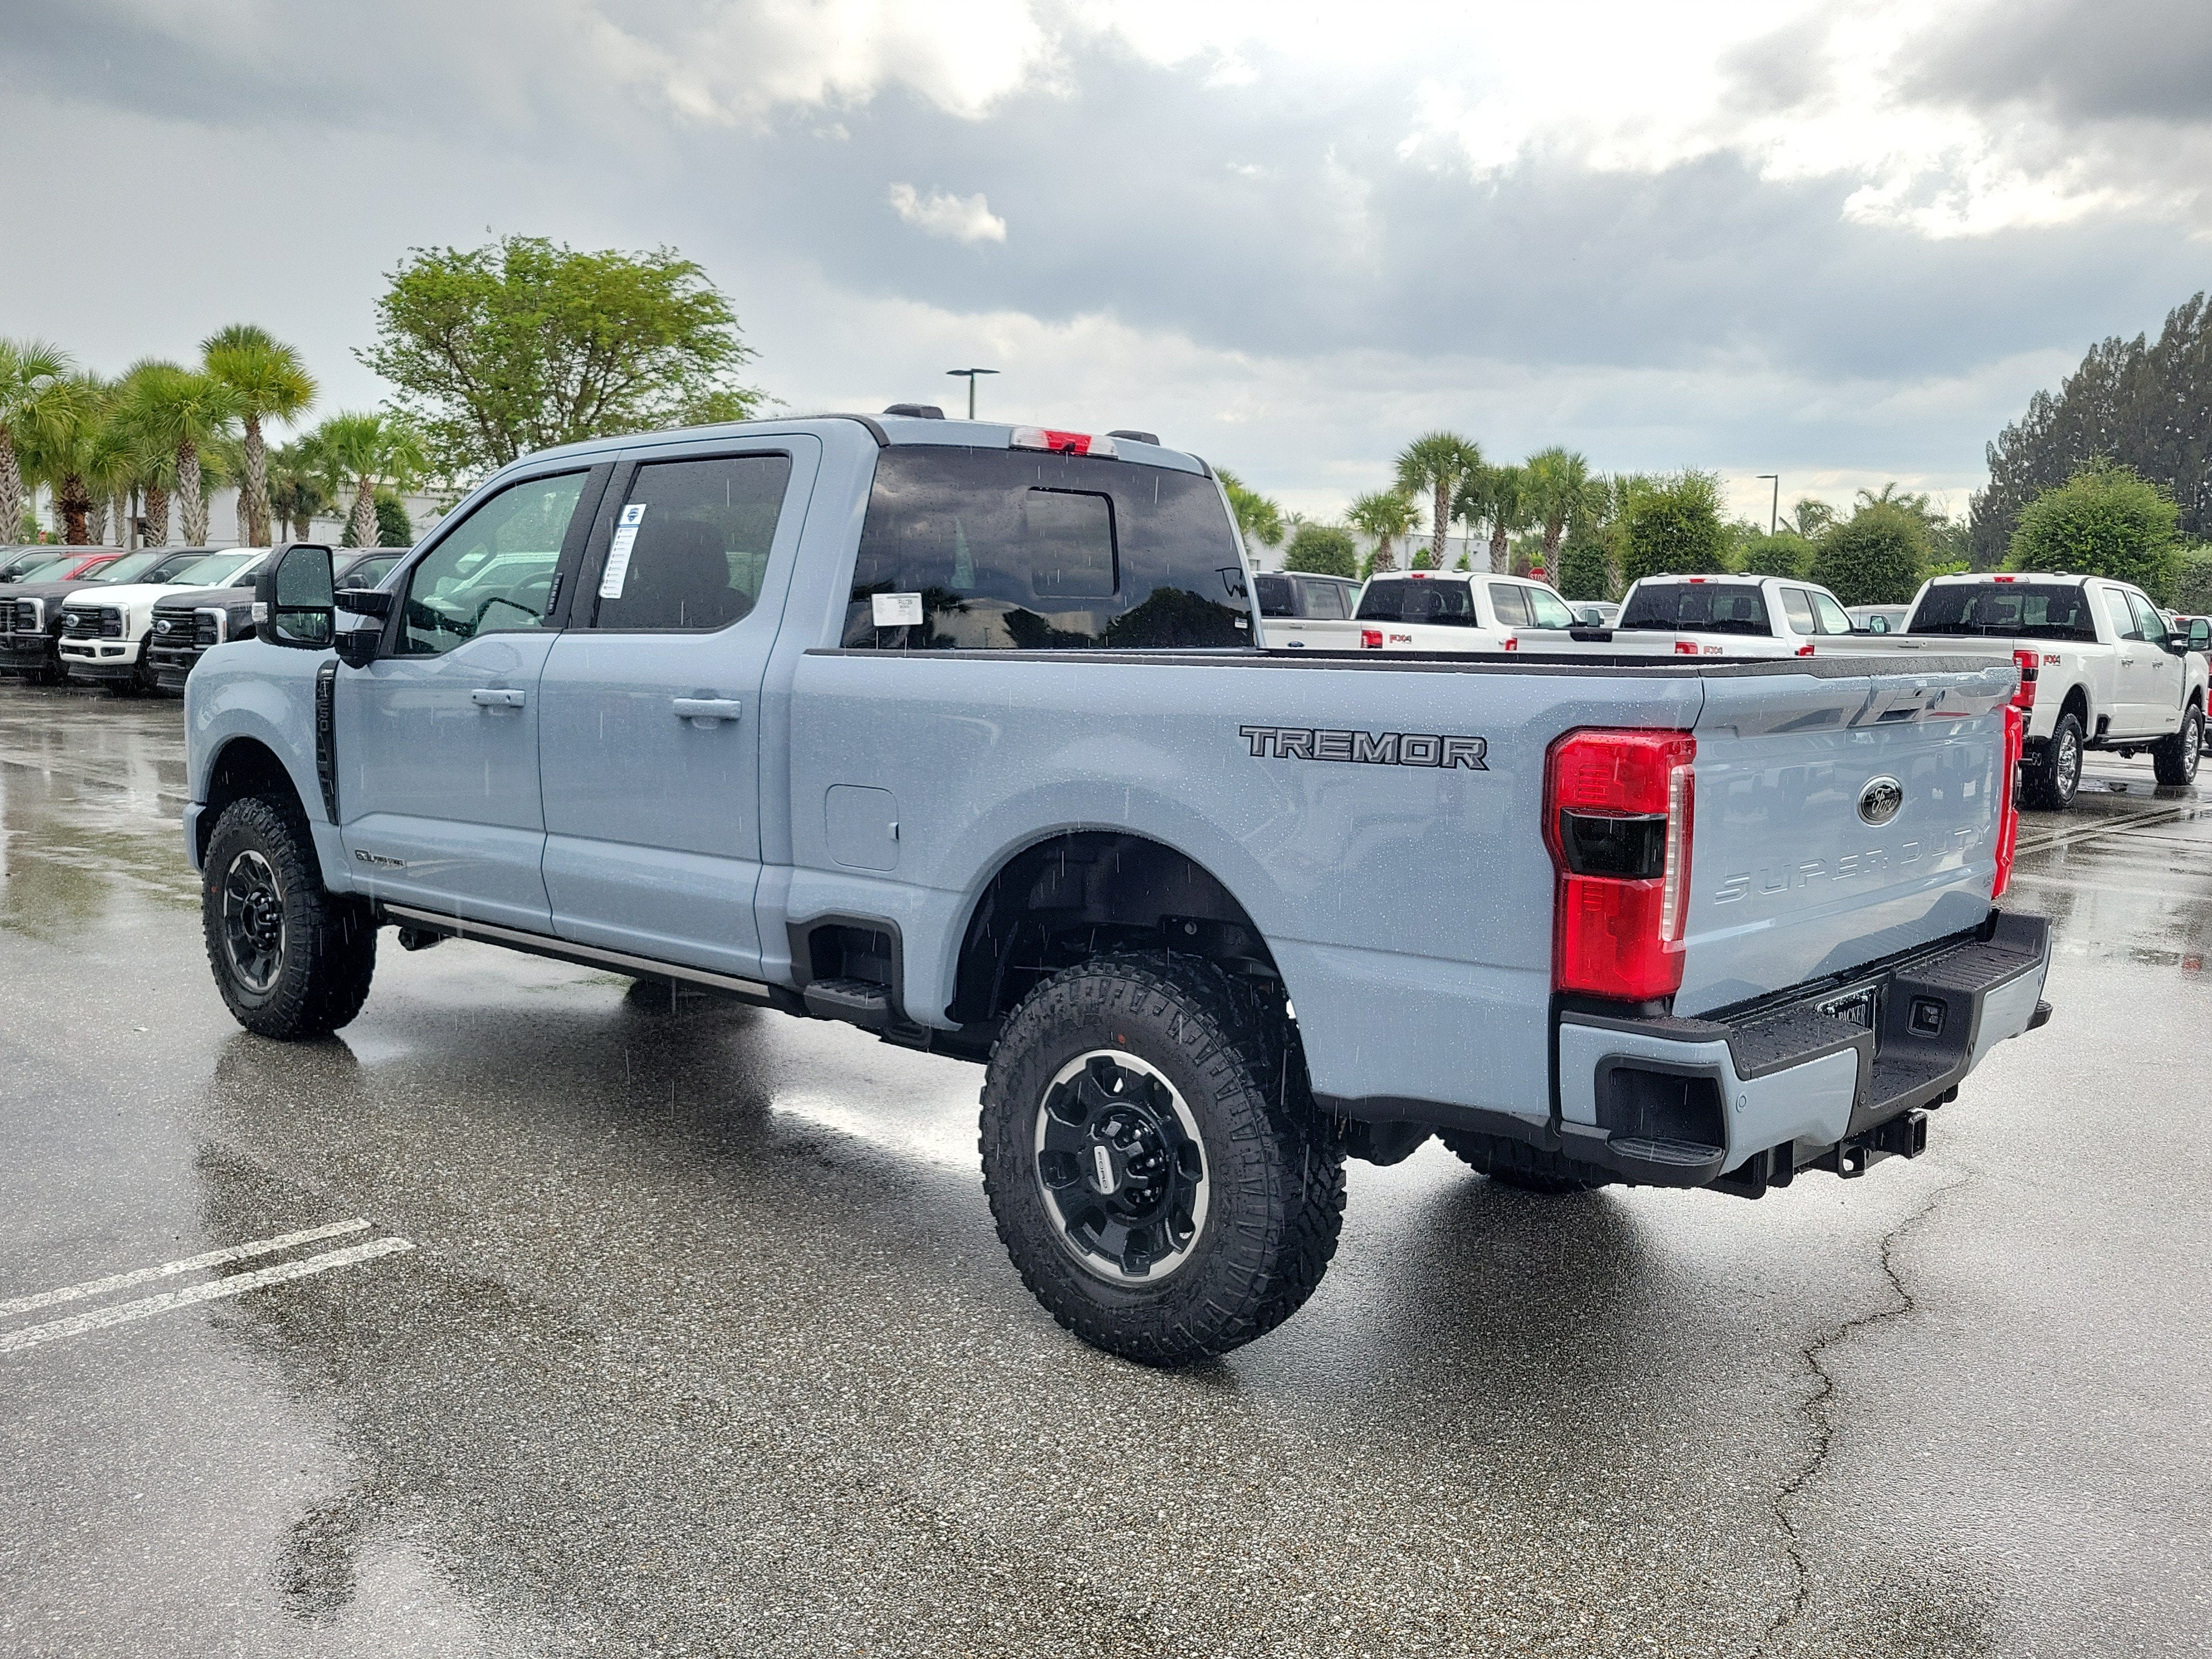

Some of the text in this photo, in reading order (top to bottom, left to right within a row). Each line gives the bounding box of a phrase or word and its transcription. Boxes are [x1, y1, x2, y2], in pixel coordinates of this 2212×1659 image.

[1530, 573, 1547, 582] STOP
[1389, 634, 1412, 644] FX4
[1703, 645, 1723, 654] FX4
[2043, 654, 2061, 666] FX4
[1239, 725, 1491, 771] TREMOR
[1871, 787, 1899, 814] Ford
[1714, 824, 1991, 905] SUPER DUTY
[1838, 1003, 1866, 1027] PACKER
